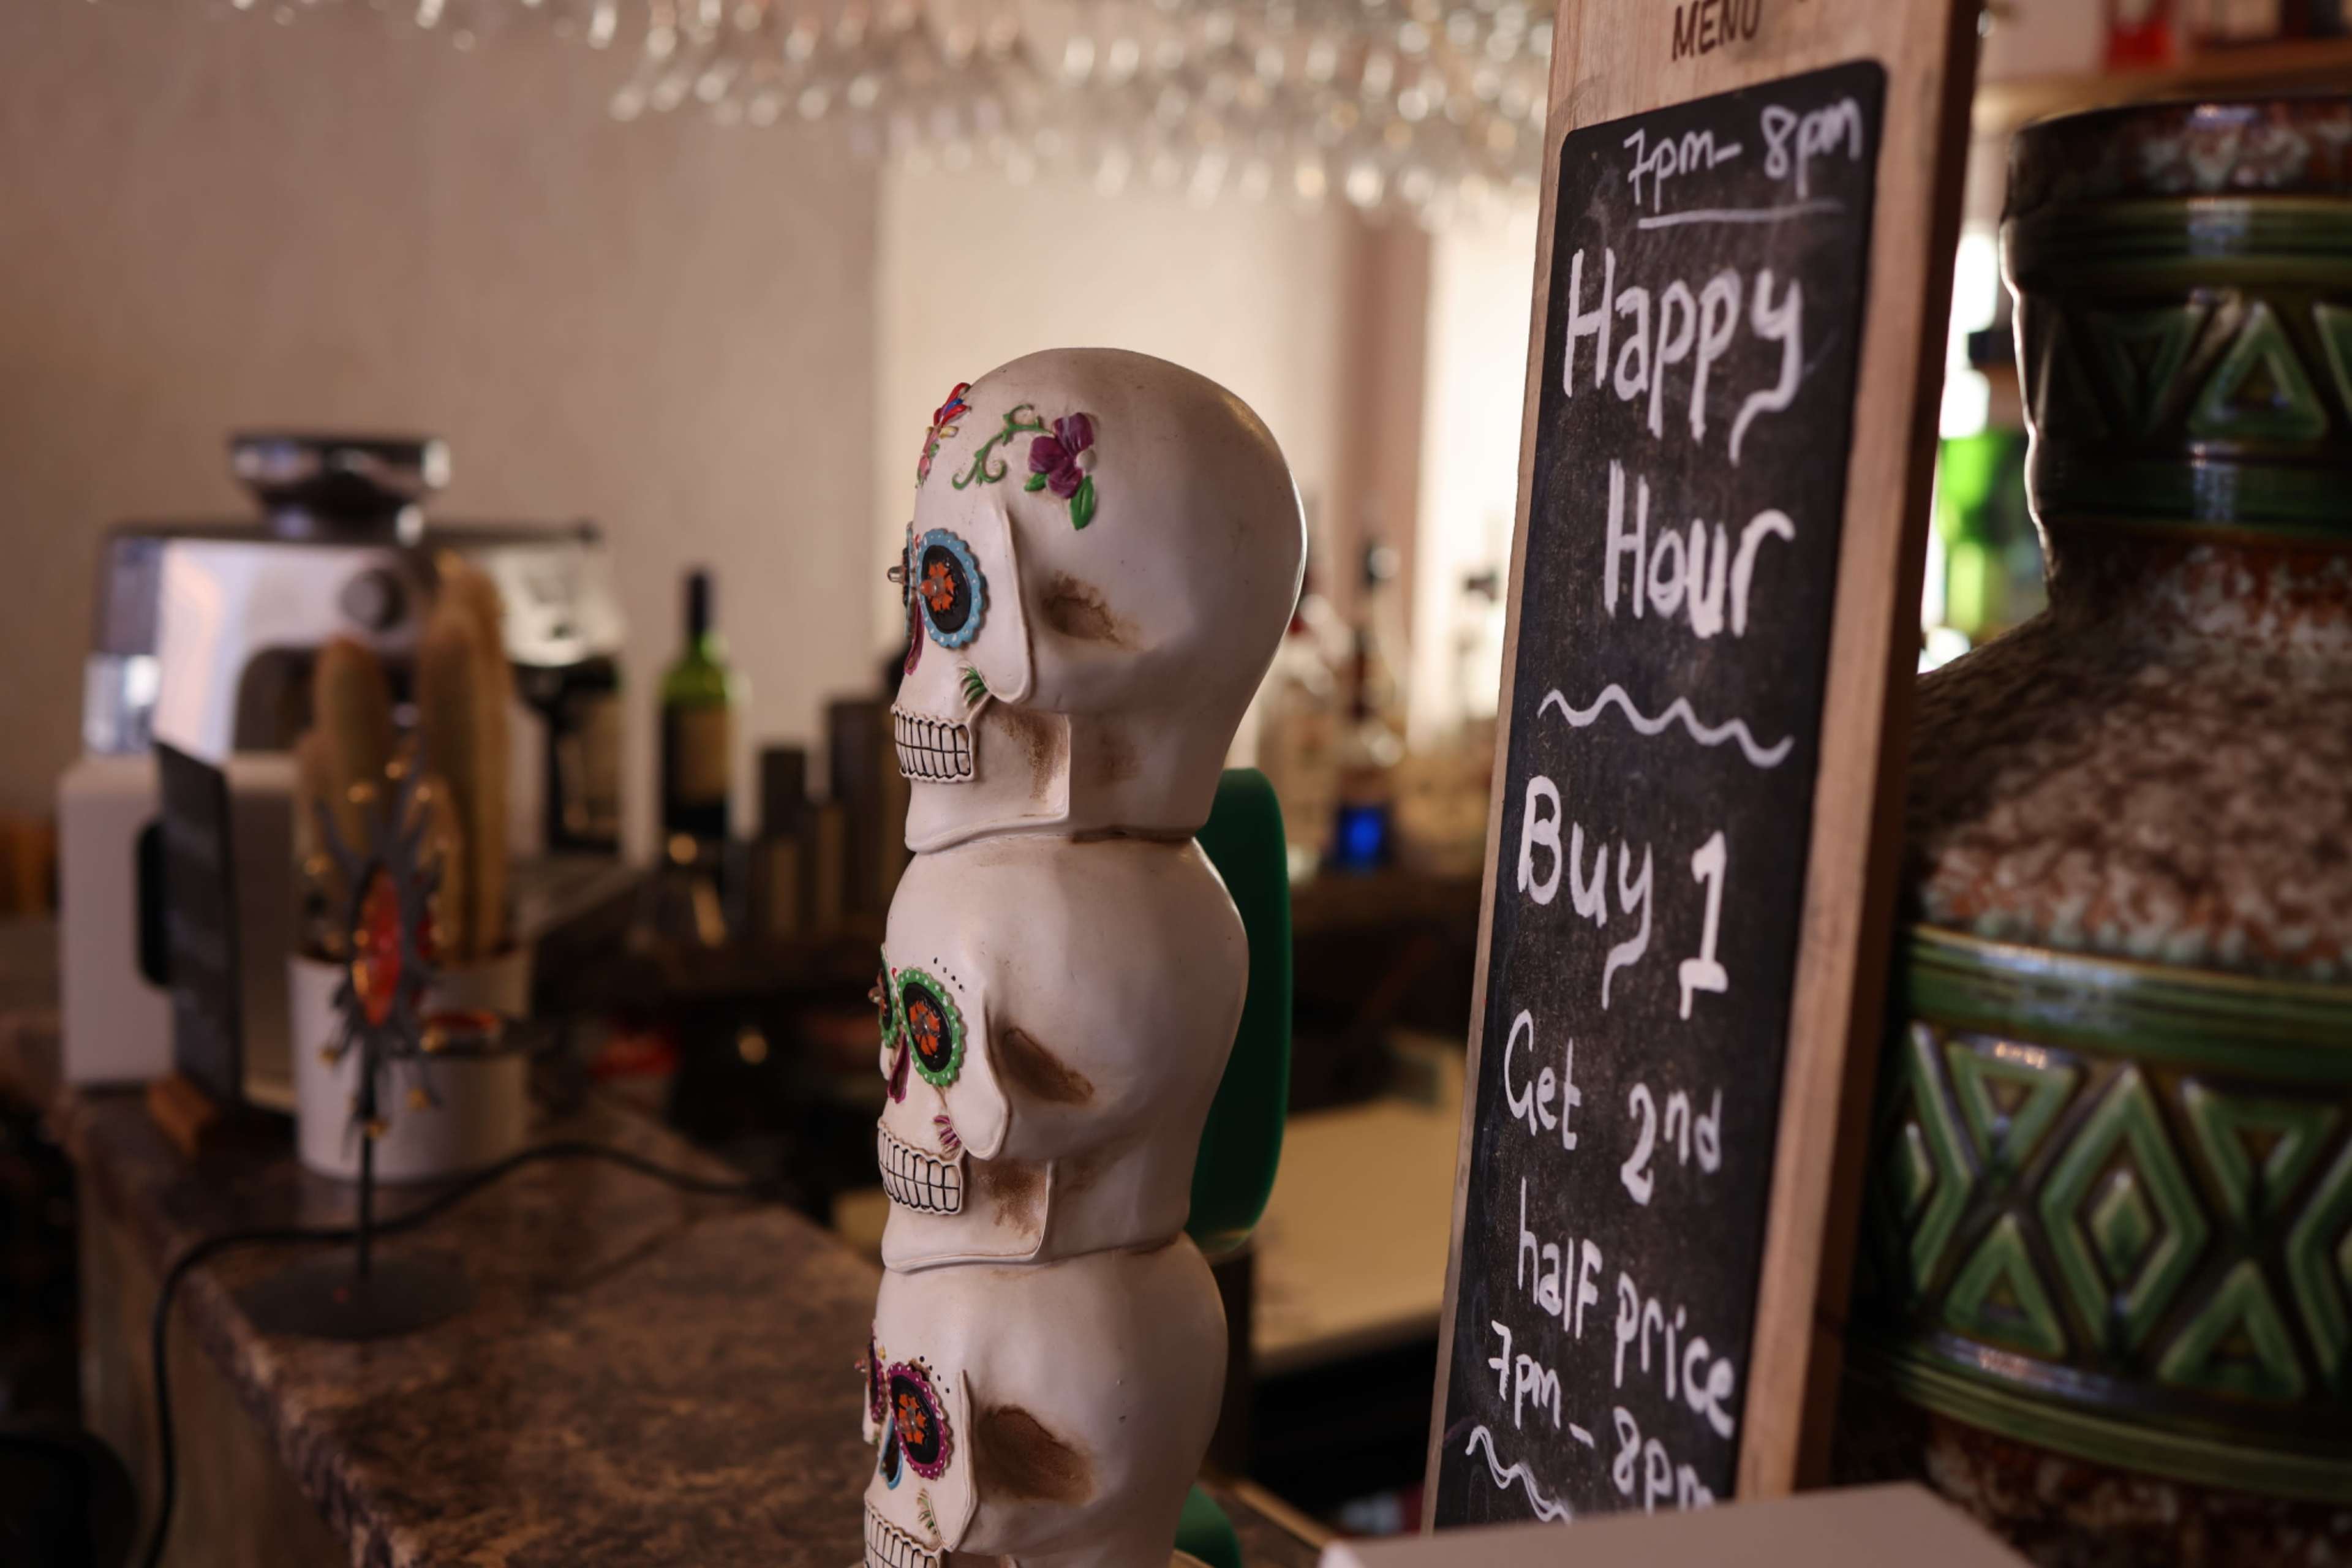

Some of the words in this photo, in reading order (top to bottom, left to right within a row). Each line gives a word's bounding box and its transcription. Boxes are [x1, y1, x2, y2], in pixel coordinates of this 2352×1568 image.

[1672, 0, 1761, 61] MENU
[1761, 97, 1862, 199] 8pm
[1563, 247, 1803, 467] Happy
[1604, 459, 1795, 639] Hour
[1517, 775, 1653, 1010] Buy
[1679, 830, 1728, 1020] 1
[1504, 1009, 1581, 1151] Get
[1620, 1082, 1723, 1207] 2nd
[1614, 1270, 1735, 1441] price
